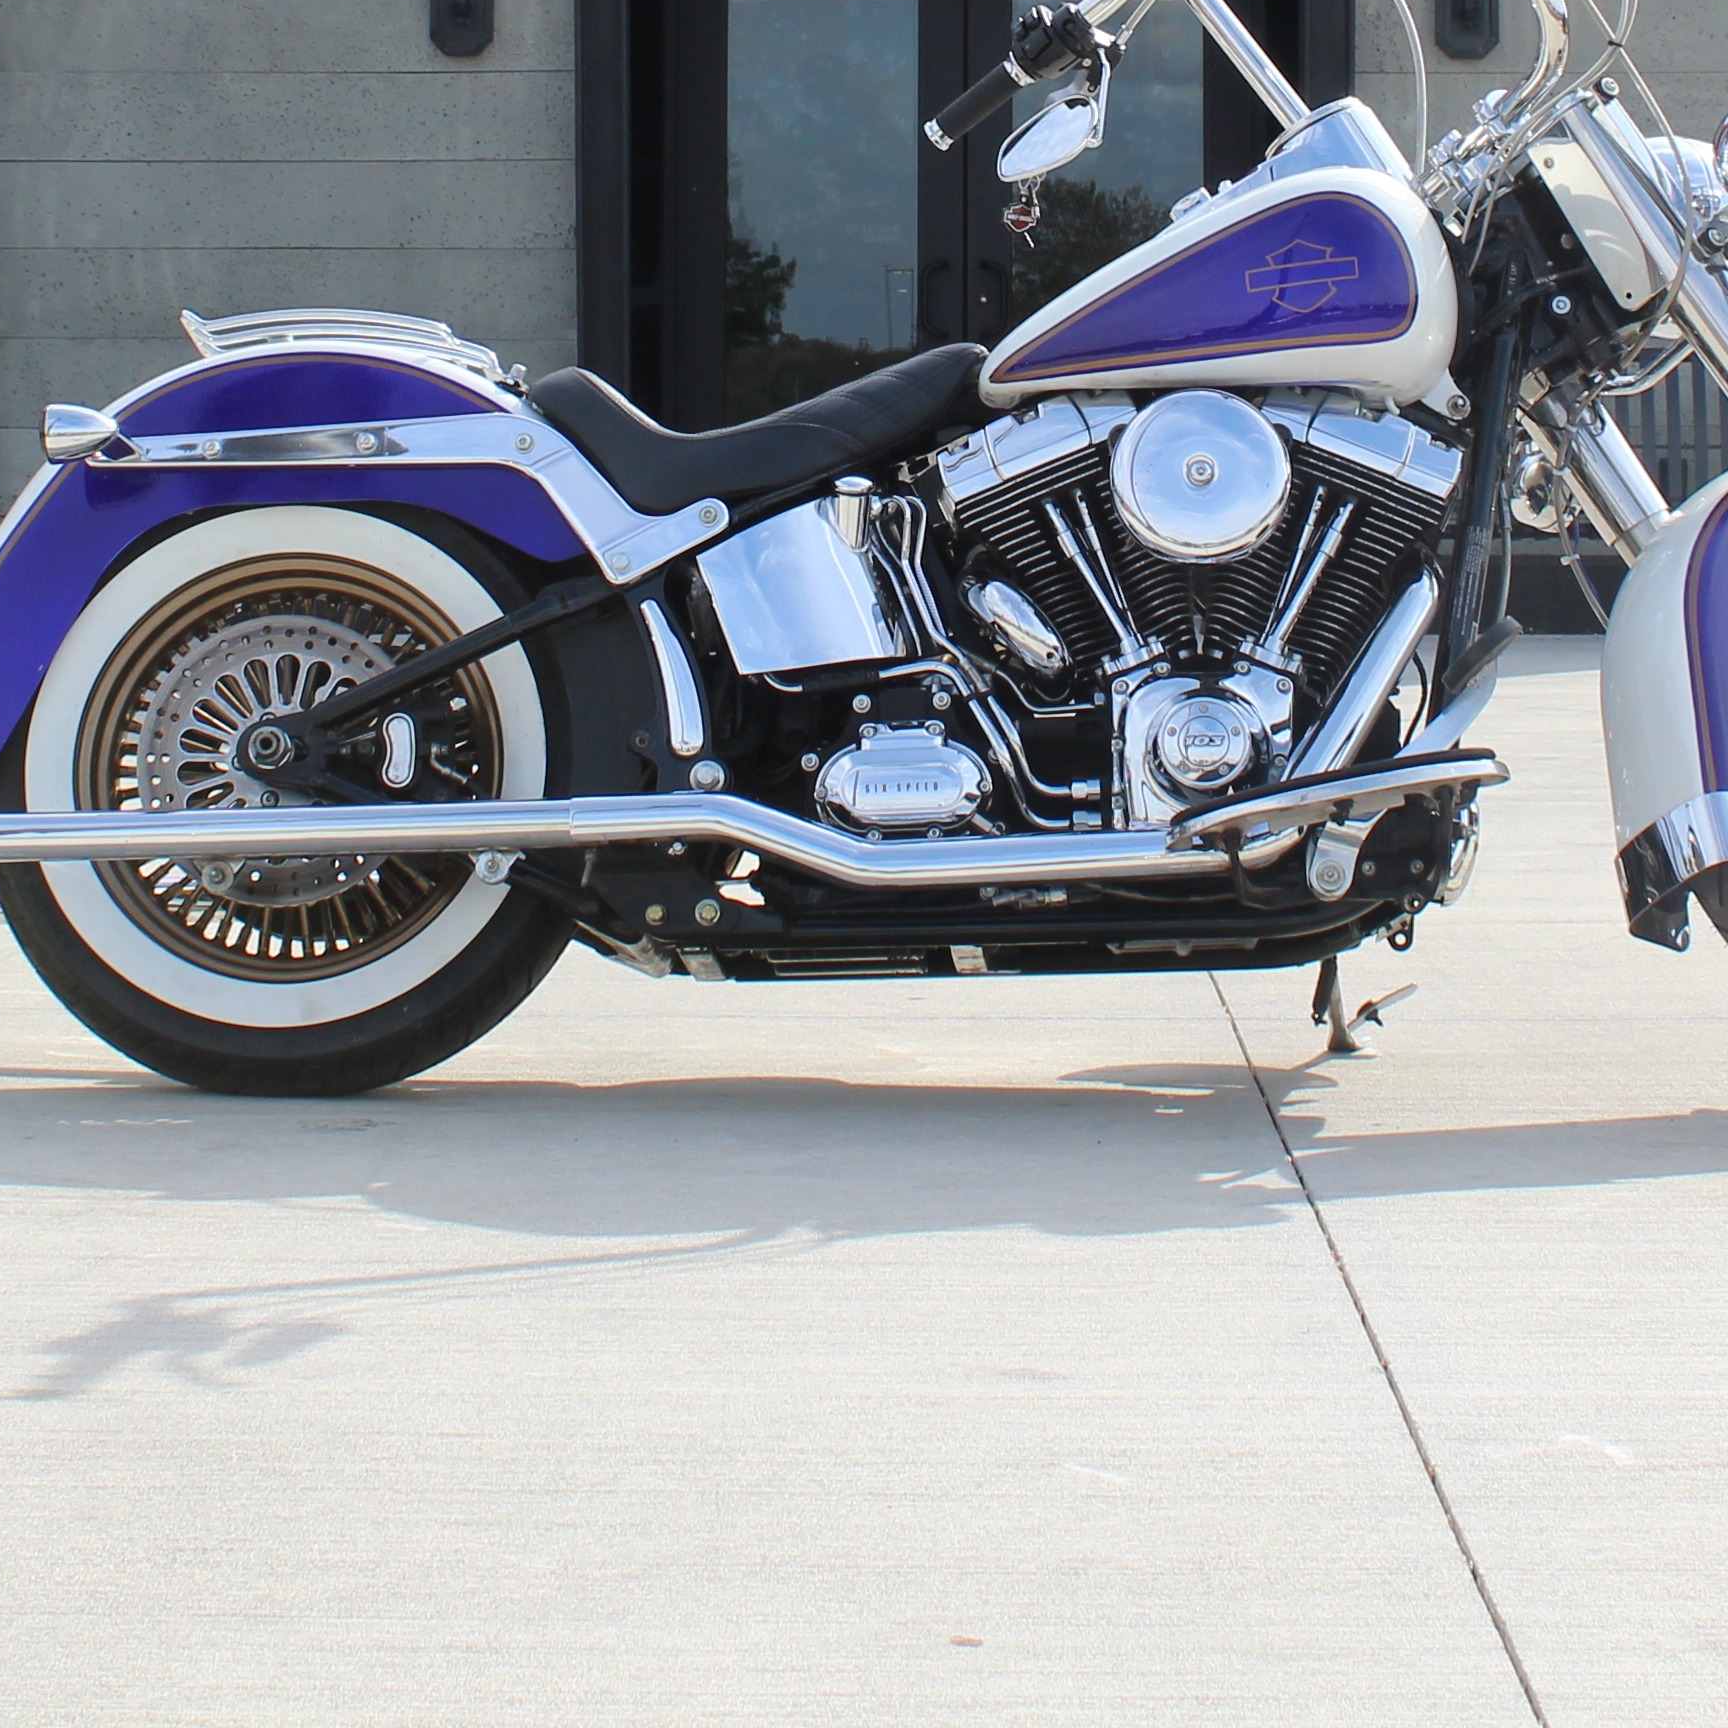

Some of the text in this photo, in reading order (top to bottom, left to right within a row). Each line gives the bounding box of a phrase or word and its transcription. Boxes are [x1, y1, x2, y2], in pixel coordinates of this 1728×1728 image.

[1185, 734, 1226, 748] 103
[865, 781, 940, 794] SIX SPEED
